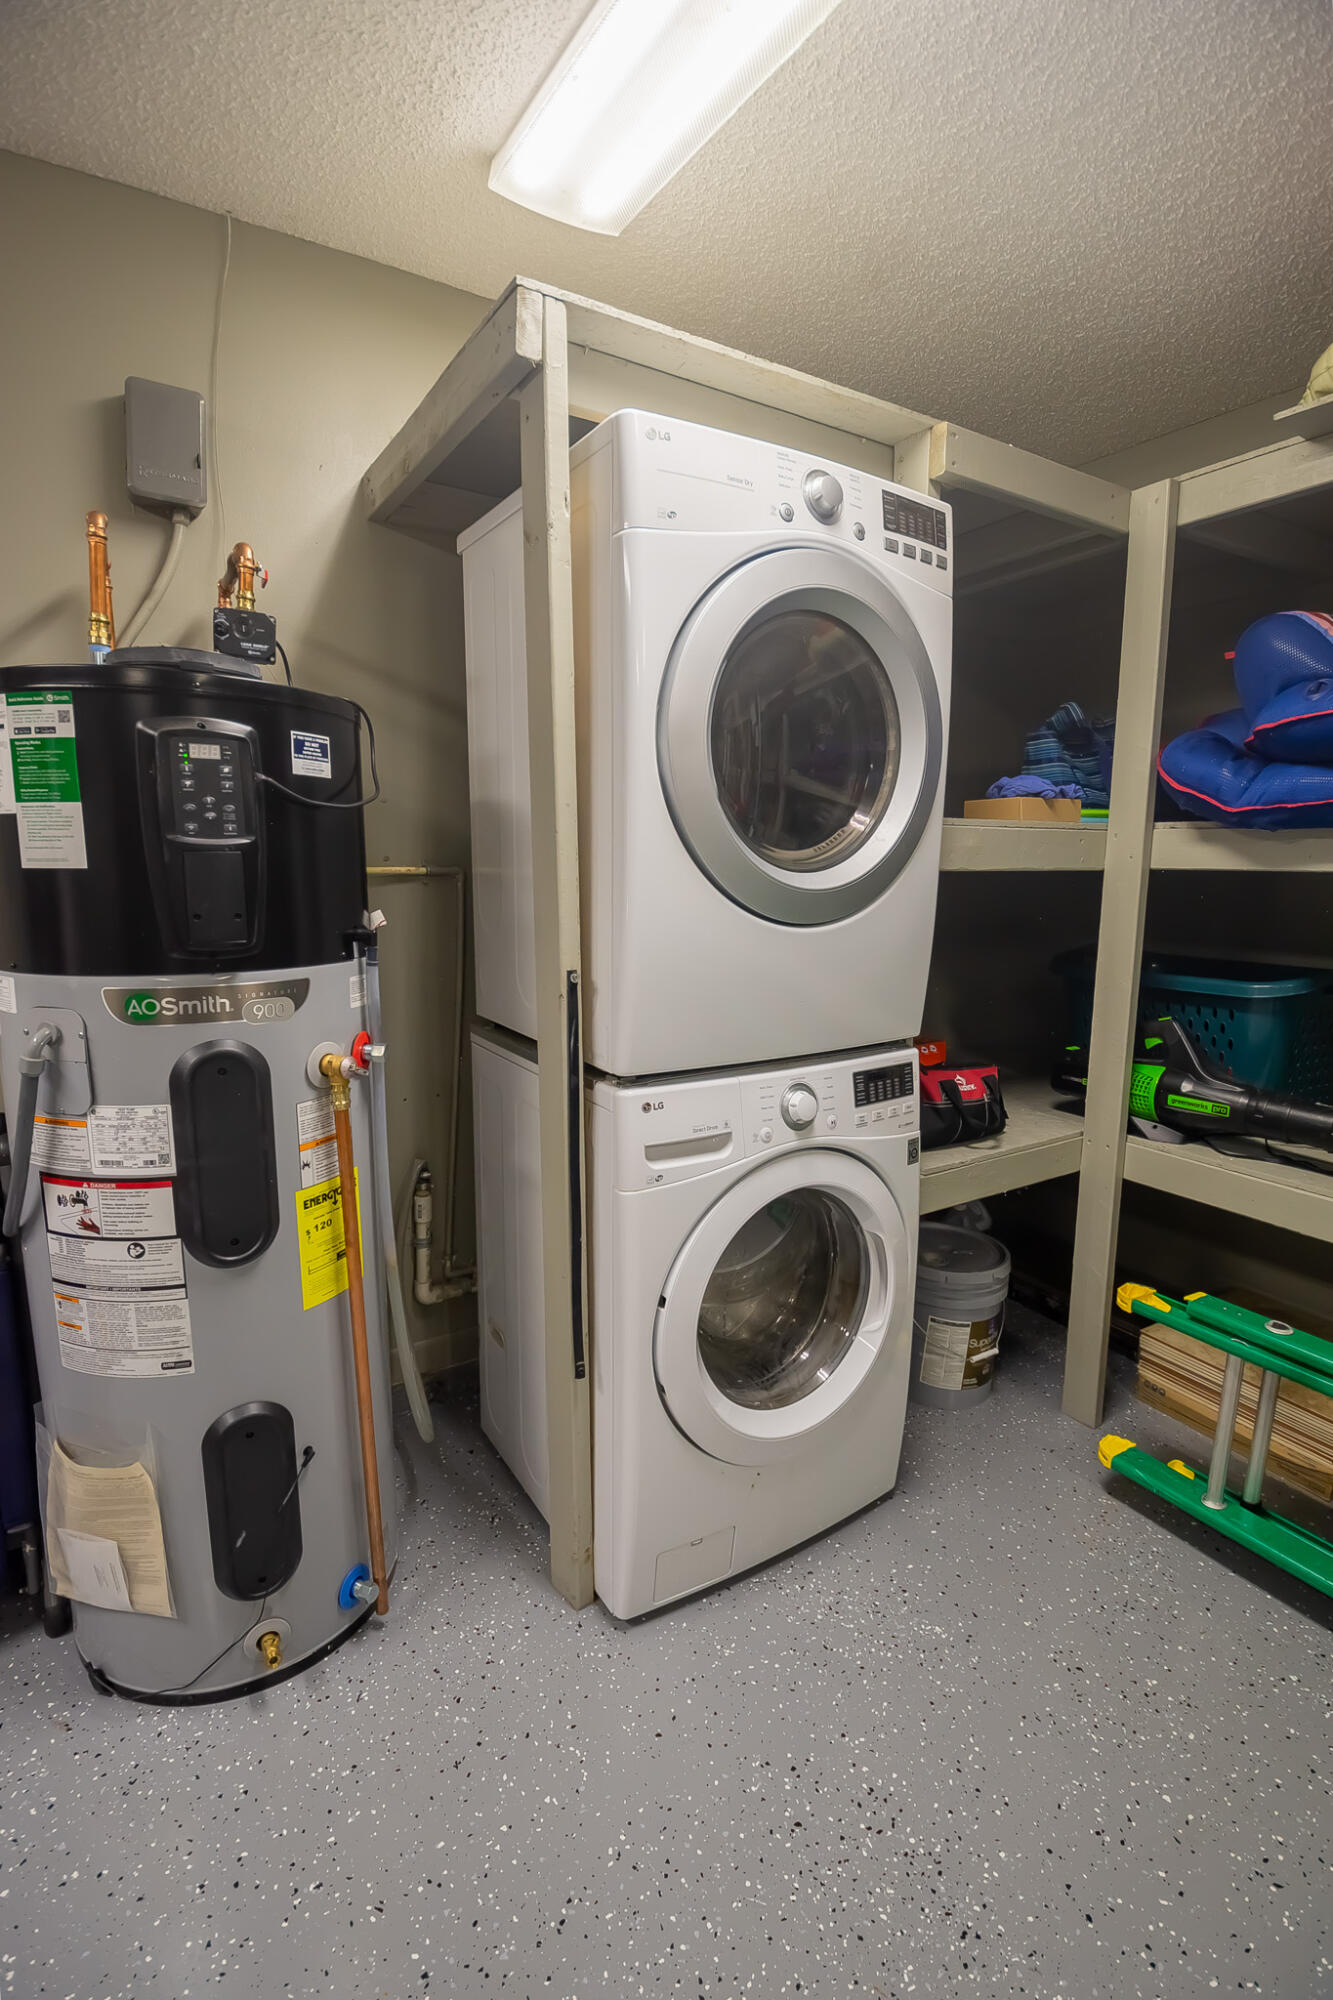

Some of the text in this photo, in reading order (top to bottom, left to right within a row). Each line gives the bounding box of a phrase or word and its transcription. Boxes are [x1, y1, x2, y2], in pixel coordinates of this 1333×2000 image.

[658, 431, 671, 441] LG
[252, 1003, 285, 1019] 900
[653, 1101, 664, 1111] LG
[1171, 1098, 1227, 1114] greenworks pro
[313, 1218, 333, 1233] 120
